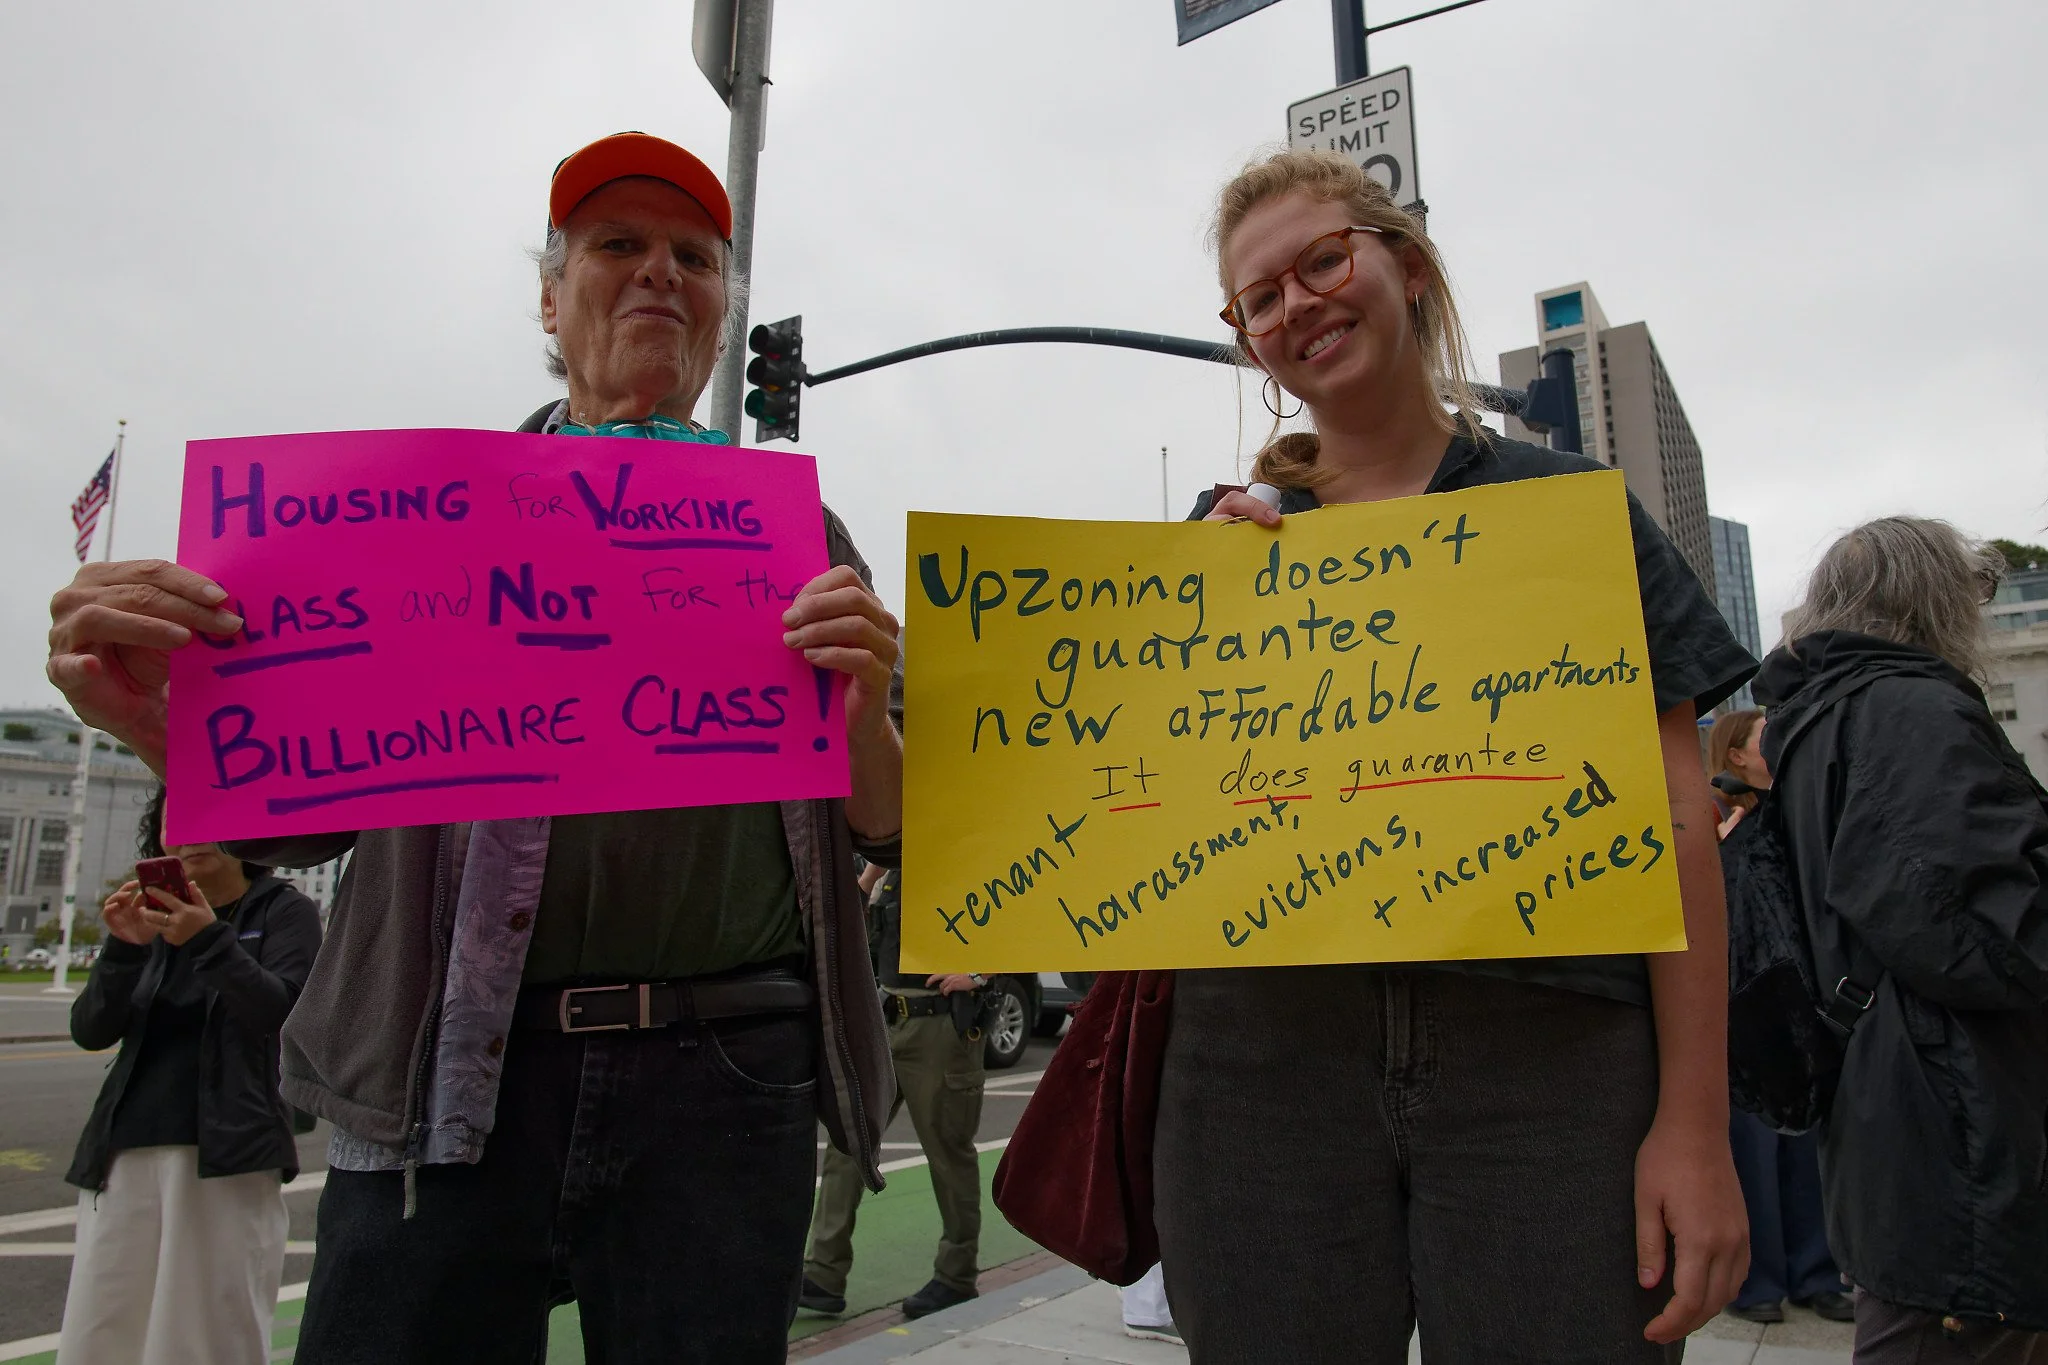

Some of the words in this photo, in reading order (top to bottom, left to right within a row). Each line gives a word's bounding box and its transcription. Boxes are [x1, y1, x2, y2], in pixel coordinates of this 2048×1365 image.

[1299, 89, 1400, 137] SPEED
[1311, 121, 1390, 154] IMIT
[211, 461, 471, 540] HOUSING
[568, 462, 764, 538] WORKING
[400, 564, 473, 623] and
[487, 561, 600, 627] NOT
[918, 544, 1205, 646] Upzoning
[1254, 511, 1481, 597] doesn't
[972, 703, 1124, 754] new
[1470, 642, 1641, 724] apartments
[1035, 597, 1401, 710] guarantee
[205, 697, 586, 791] BILLIONAIRE
[1091, 756, 1161, 801] It
[1219, 747, 1310, 796] does
[1338, 732, 1549, 804] guarantee
[936, 812, 1089, 946] tenant
[1056, 794, 1301, 949] harassment,
[1221, 814, 1422, 948] evictions,
[1417, 759, 1618, 904] increased
[1514, 825, 1665, 937] prices
